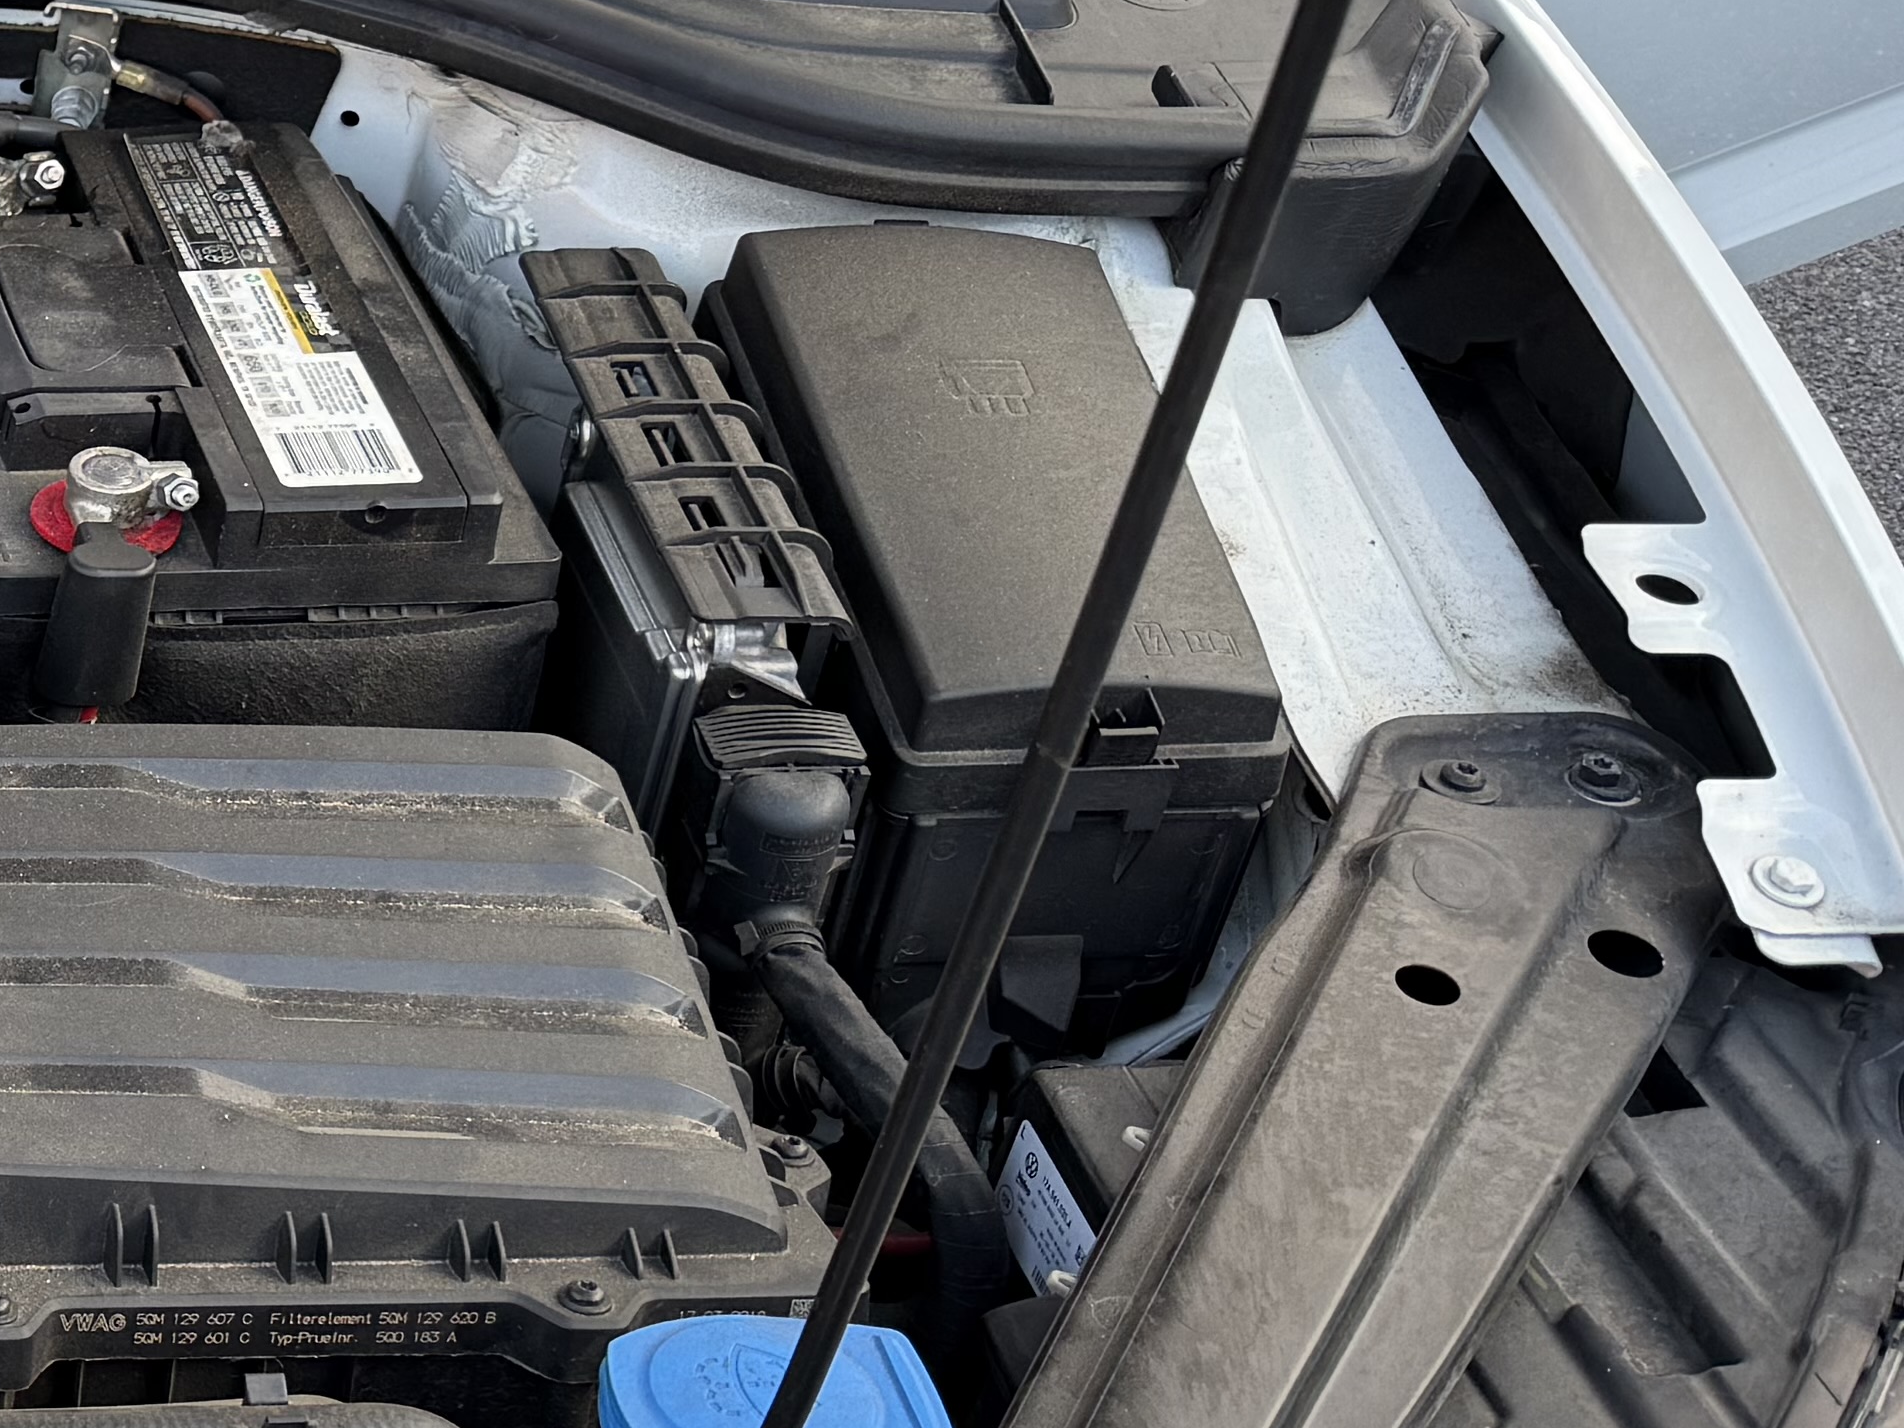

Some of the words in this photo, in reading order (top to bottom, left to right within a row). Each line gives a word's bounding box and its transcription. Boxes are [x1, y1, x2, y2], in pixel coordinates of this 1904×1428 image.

[292, 280, 339, 340] Duralast
[59, 1313, 127, 1332] VWAG
[174, 1312, 199, 1326] 129
[207, 1312, 235, 1326] 607
[242, 1312, 253, 1326] C
[270, 1311, 371, 1327] Filterelement
[417, 1311, 443, 1325] 129
[449, 1311, 480, 1325] 620
[172, 1331, 198, 1345] 129
[204, 1331, 231, 1344] 601
[240, 1331, 251, 1344] C
[414, 1330, 440, 1343] 183
[446, 1330, 458, 1343] A
